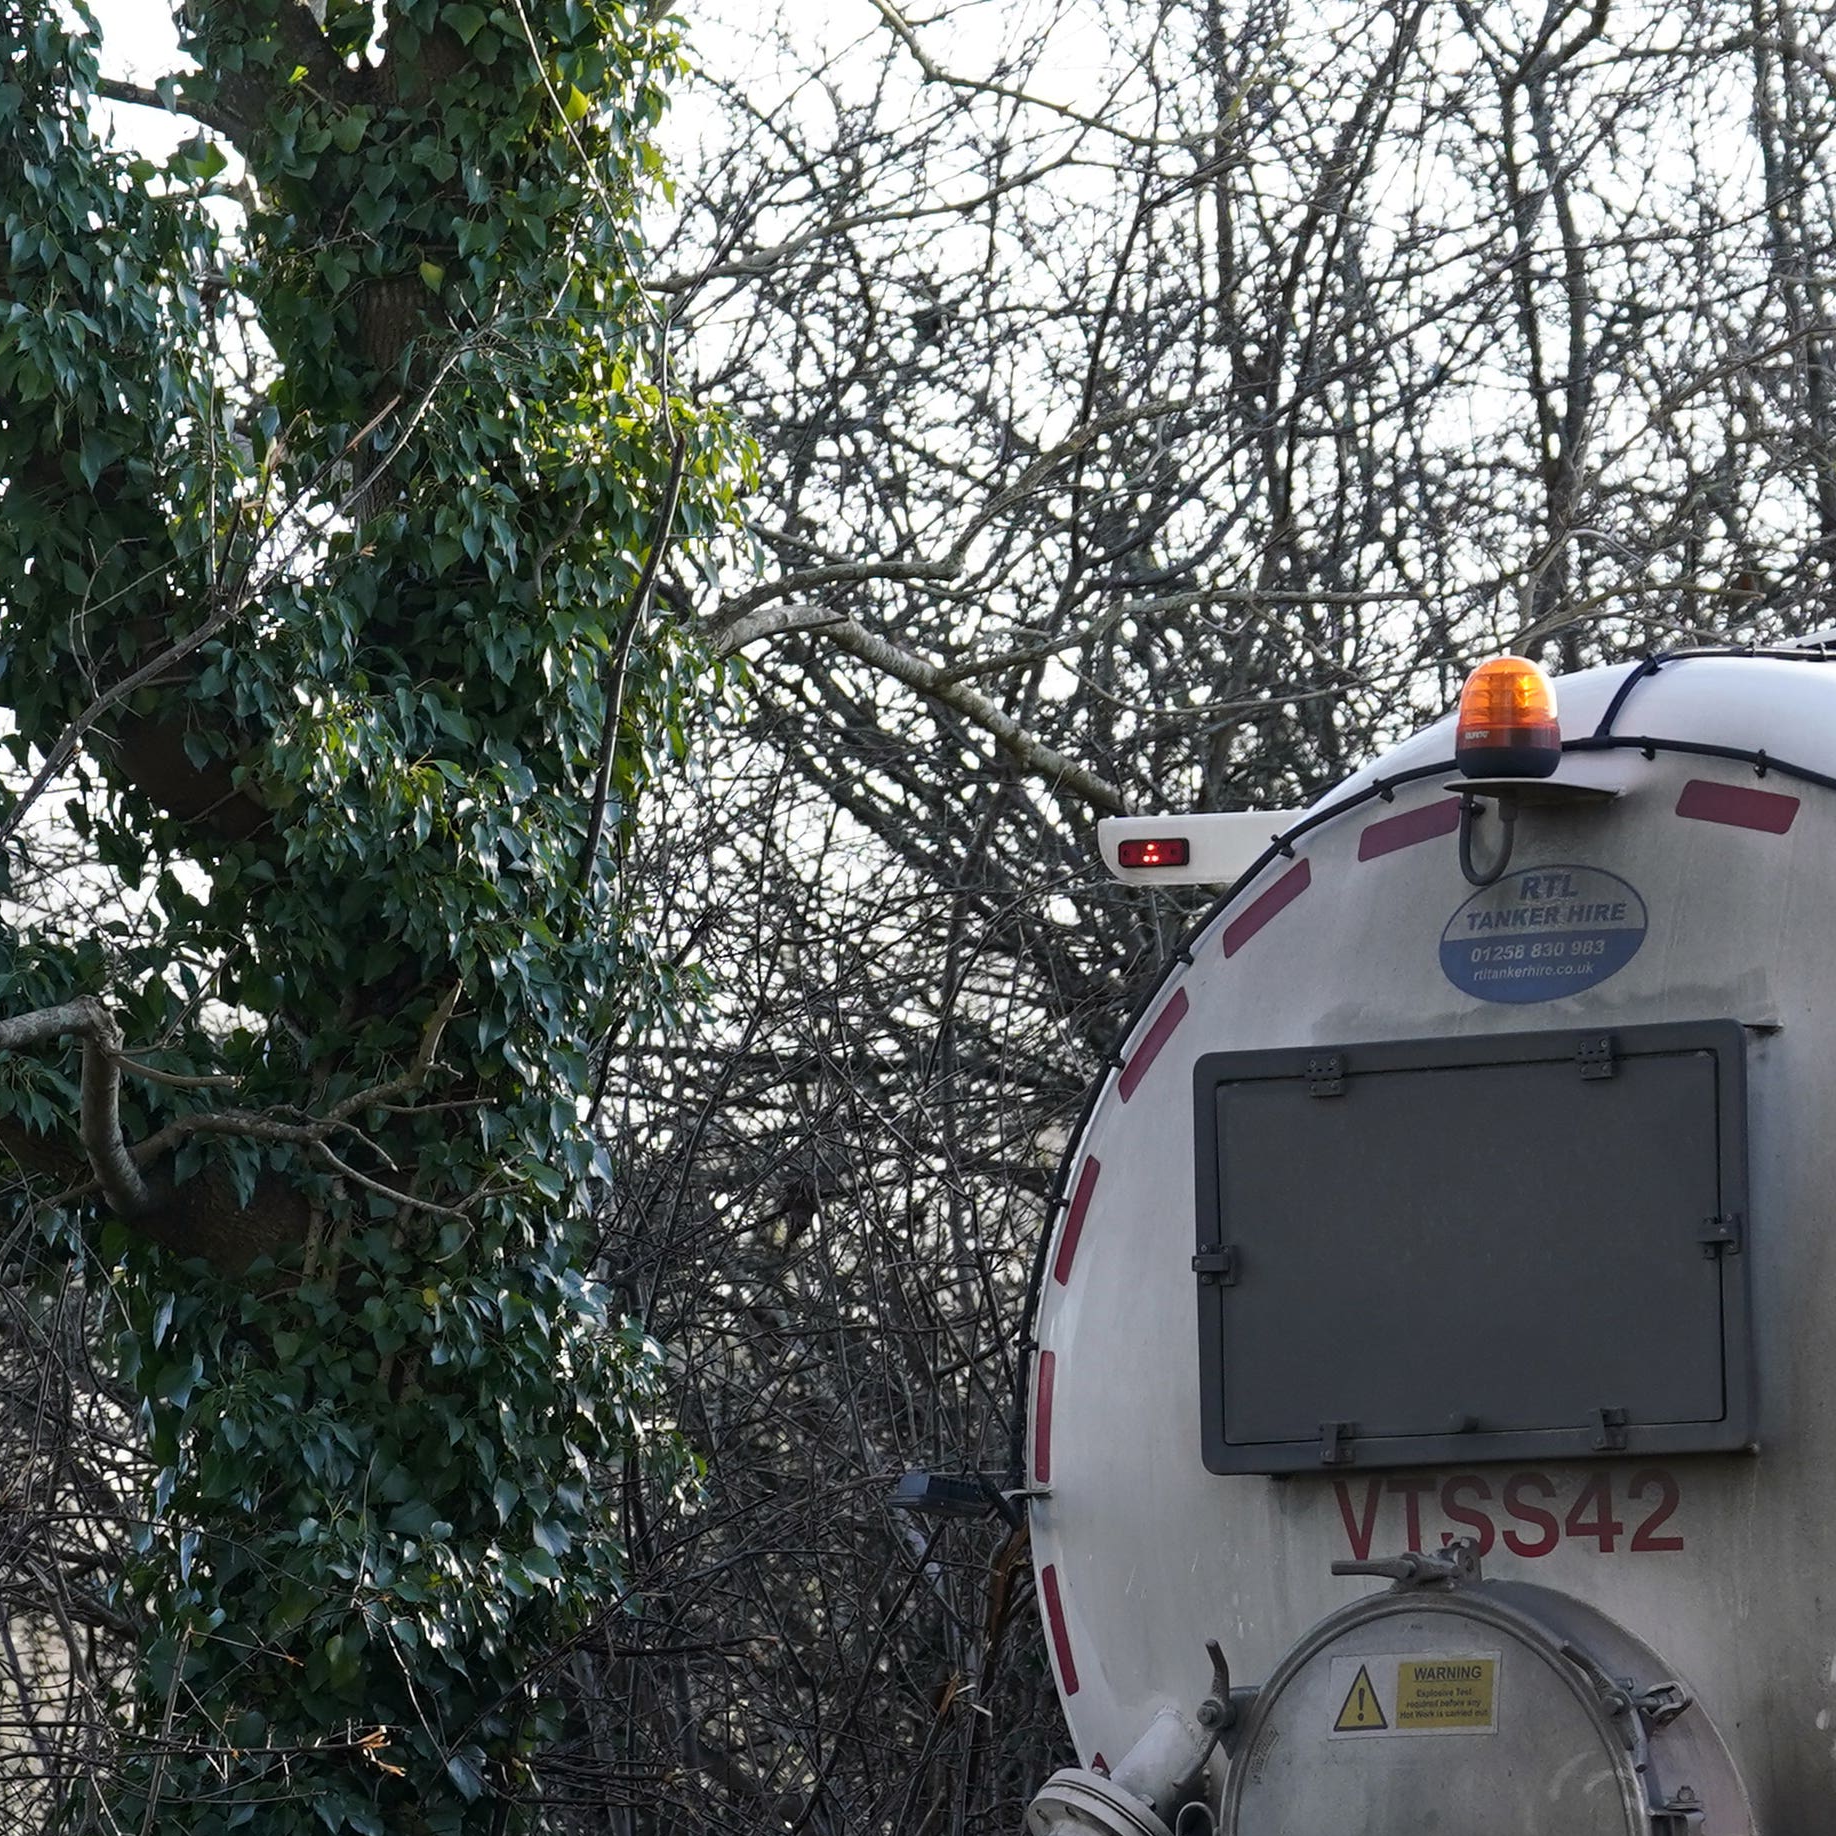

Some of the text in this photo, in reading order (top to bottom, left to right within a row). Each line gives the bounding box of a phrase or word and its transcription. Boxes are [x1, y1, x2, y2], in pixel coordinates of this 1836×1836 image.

[1520, 874, 1579, 902] RTL
[1467, 903, 1626, 931] TANKER HIRE
[1470, 939, 1605, 963] 01258 830 983
[1333, 1468, 1684, 1561] VTSS42
[1414, 1666, 1482, 1680] WARNING
